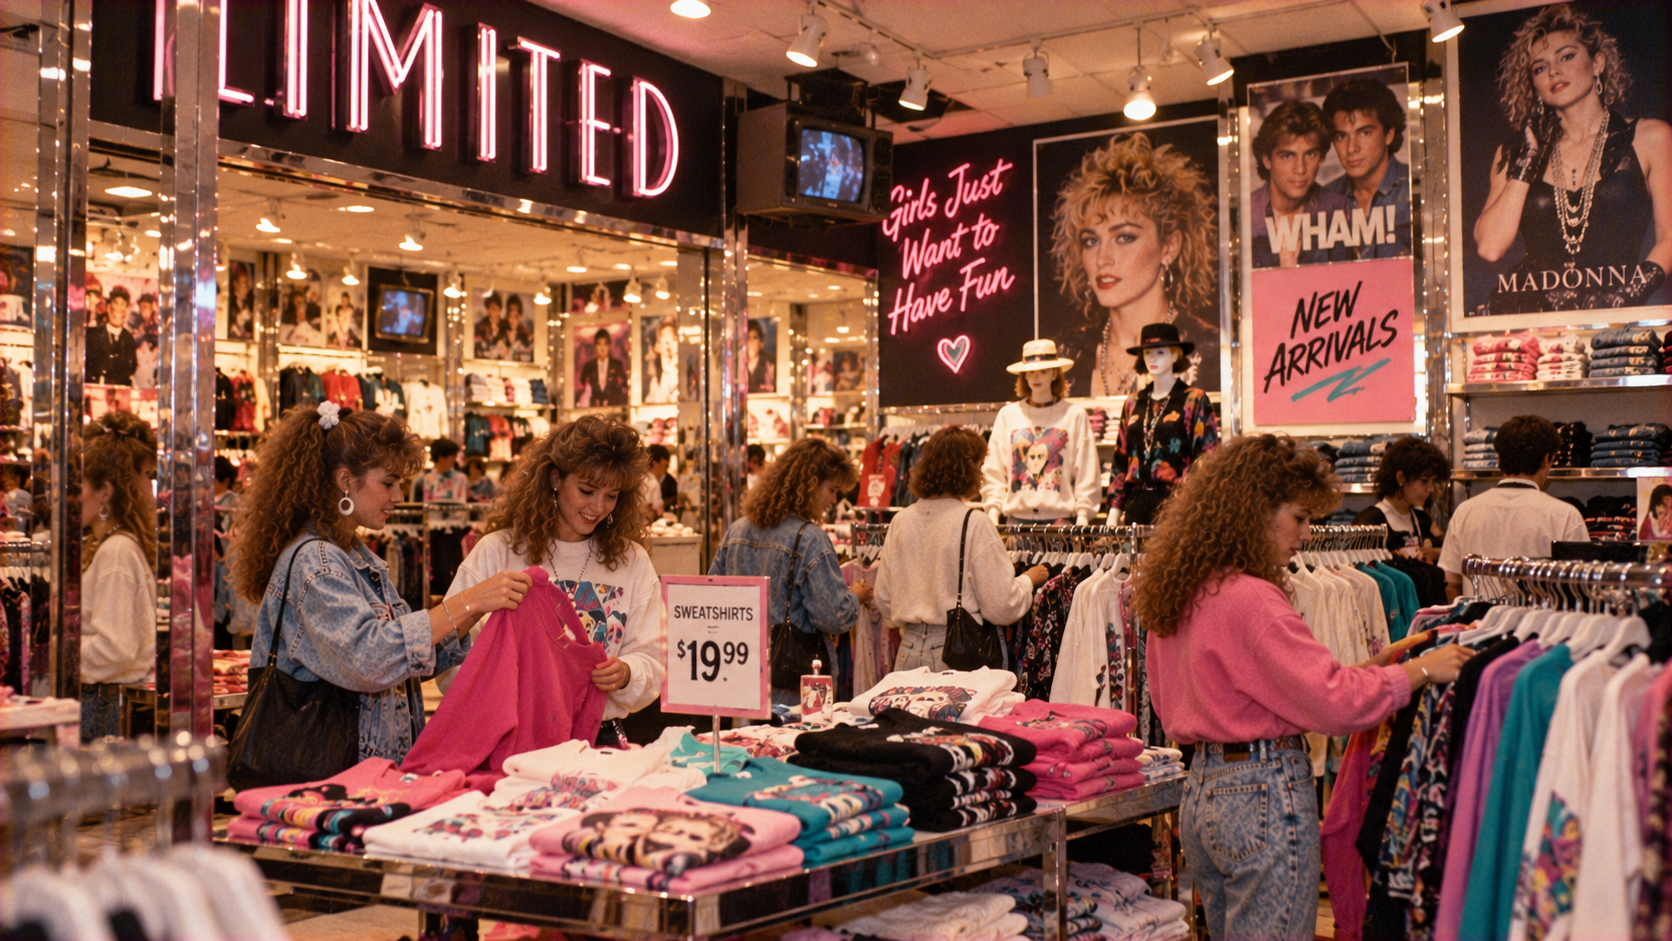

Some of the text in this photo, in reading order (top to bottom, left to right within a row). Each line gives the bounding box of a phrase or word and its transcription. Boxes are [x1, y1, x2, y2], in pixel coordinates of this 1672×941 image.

[882, 158, 1013, 242] Girls Just
[1265, 205, 1396, 254] WHAM!
[903, 213, 1000, 280] Want to
[887, 257, 1015, 336] Have Fun
[1290, 280, 1363, 340] NEW
[1497, 264, 1647, 293] MADONNA
[1264, 309, 1399, 394] ARRIVALS
[674, 605, 754, 621] SWEATSHIRTS
